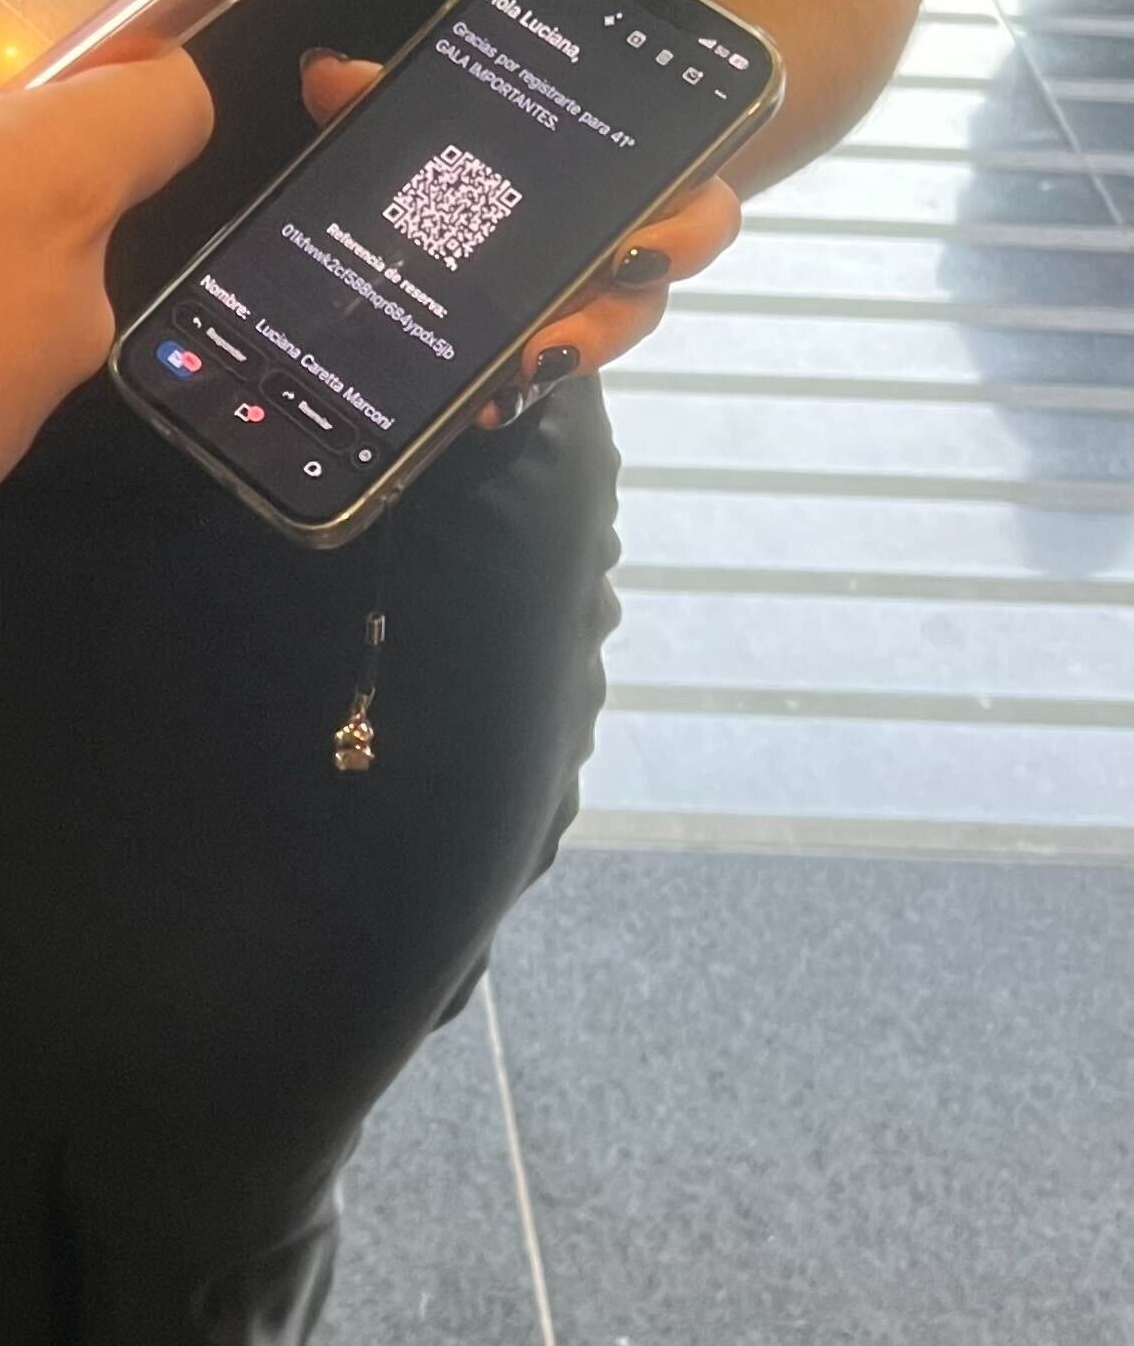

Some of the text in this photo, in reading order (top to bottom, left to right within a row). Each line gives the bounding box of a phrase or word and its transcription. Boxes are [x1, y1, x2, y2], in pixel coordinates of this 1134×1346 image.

[435, 39, 559, 131] GALA IMPORTANTES.
[453, 21, 499, 58] Gracias
[495, 54, 520, 77] por
[518, 66, 582, 116] registrarte
[578, 111, 611, 136] para
[519, 10, 581, 63] Luciana,
[326, 222, 448, 319] Referencia de reserva:
[200, 274, 251, 320] Nombre:
[255, 318, 302, 359] Luciana
[300, 353, 344, 394] Caretta
[342, 387, 395, 430] Marconi
